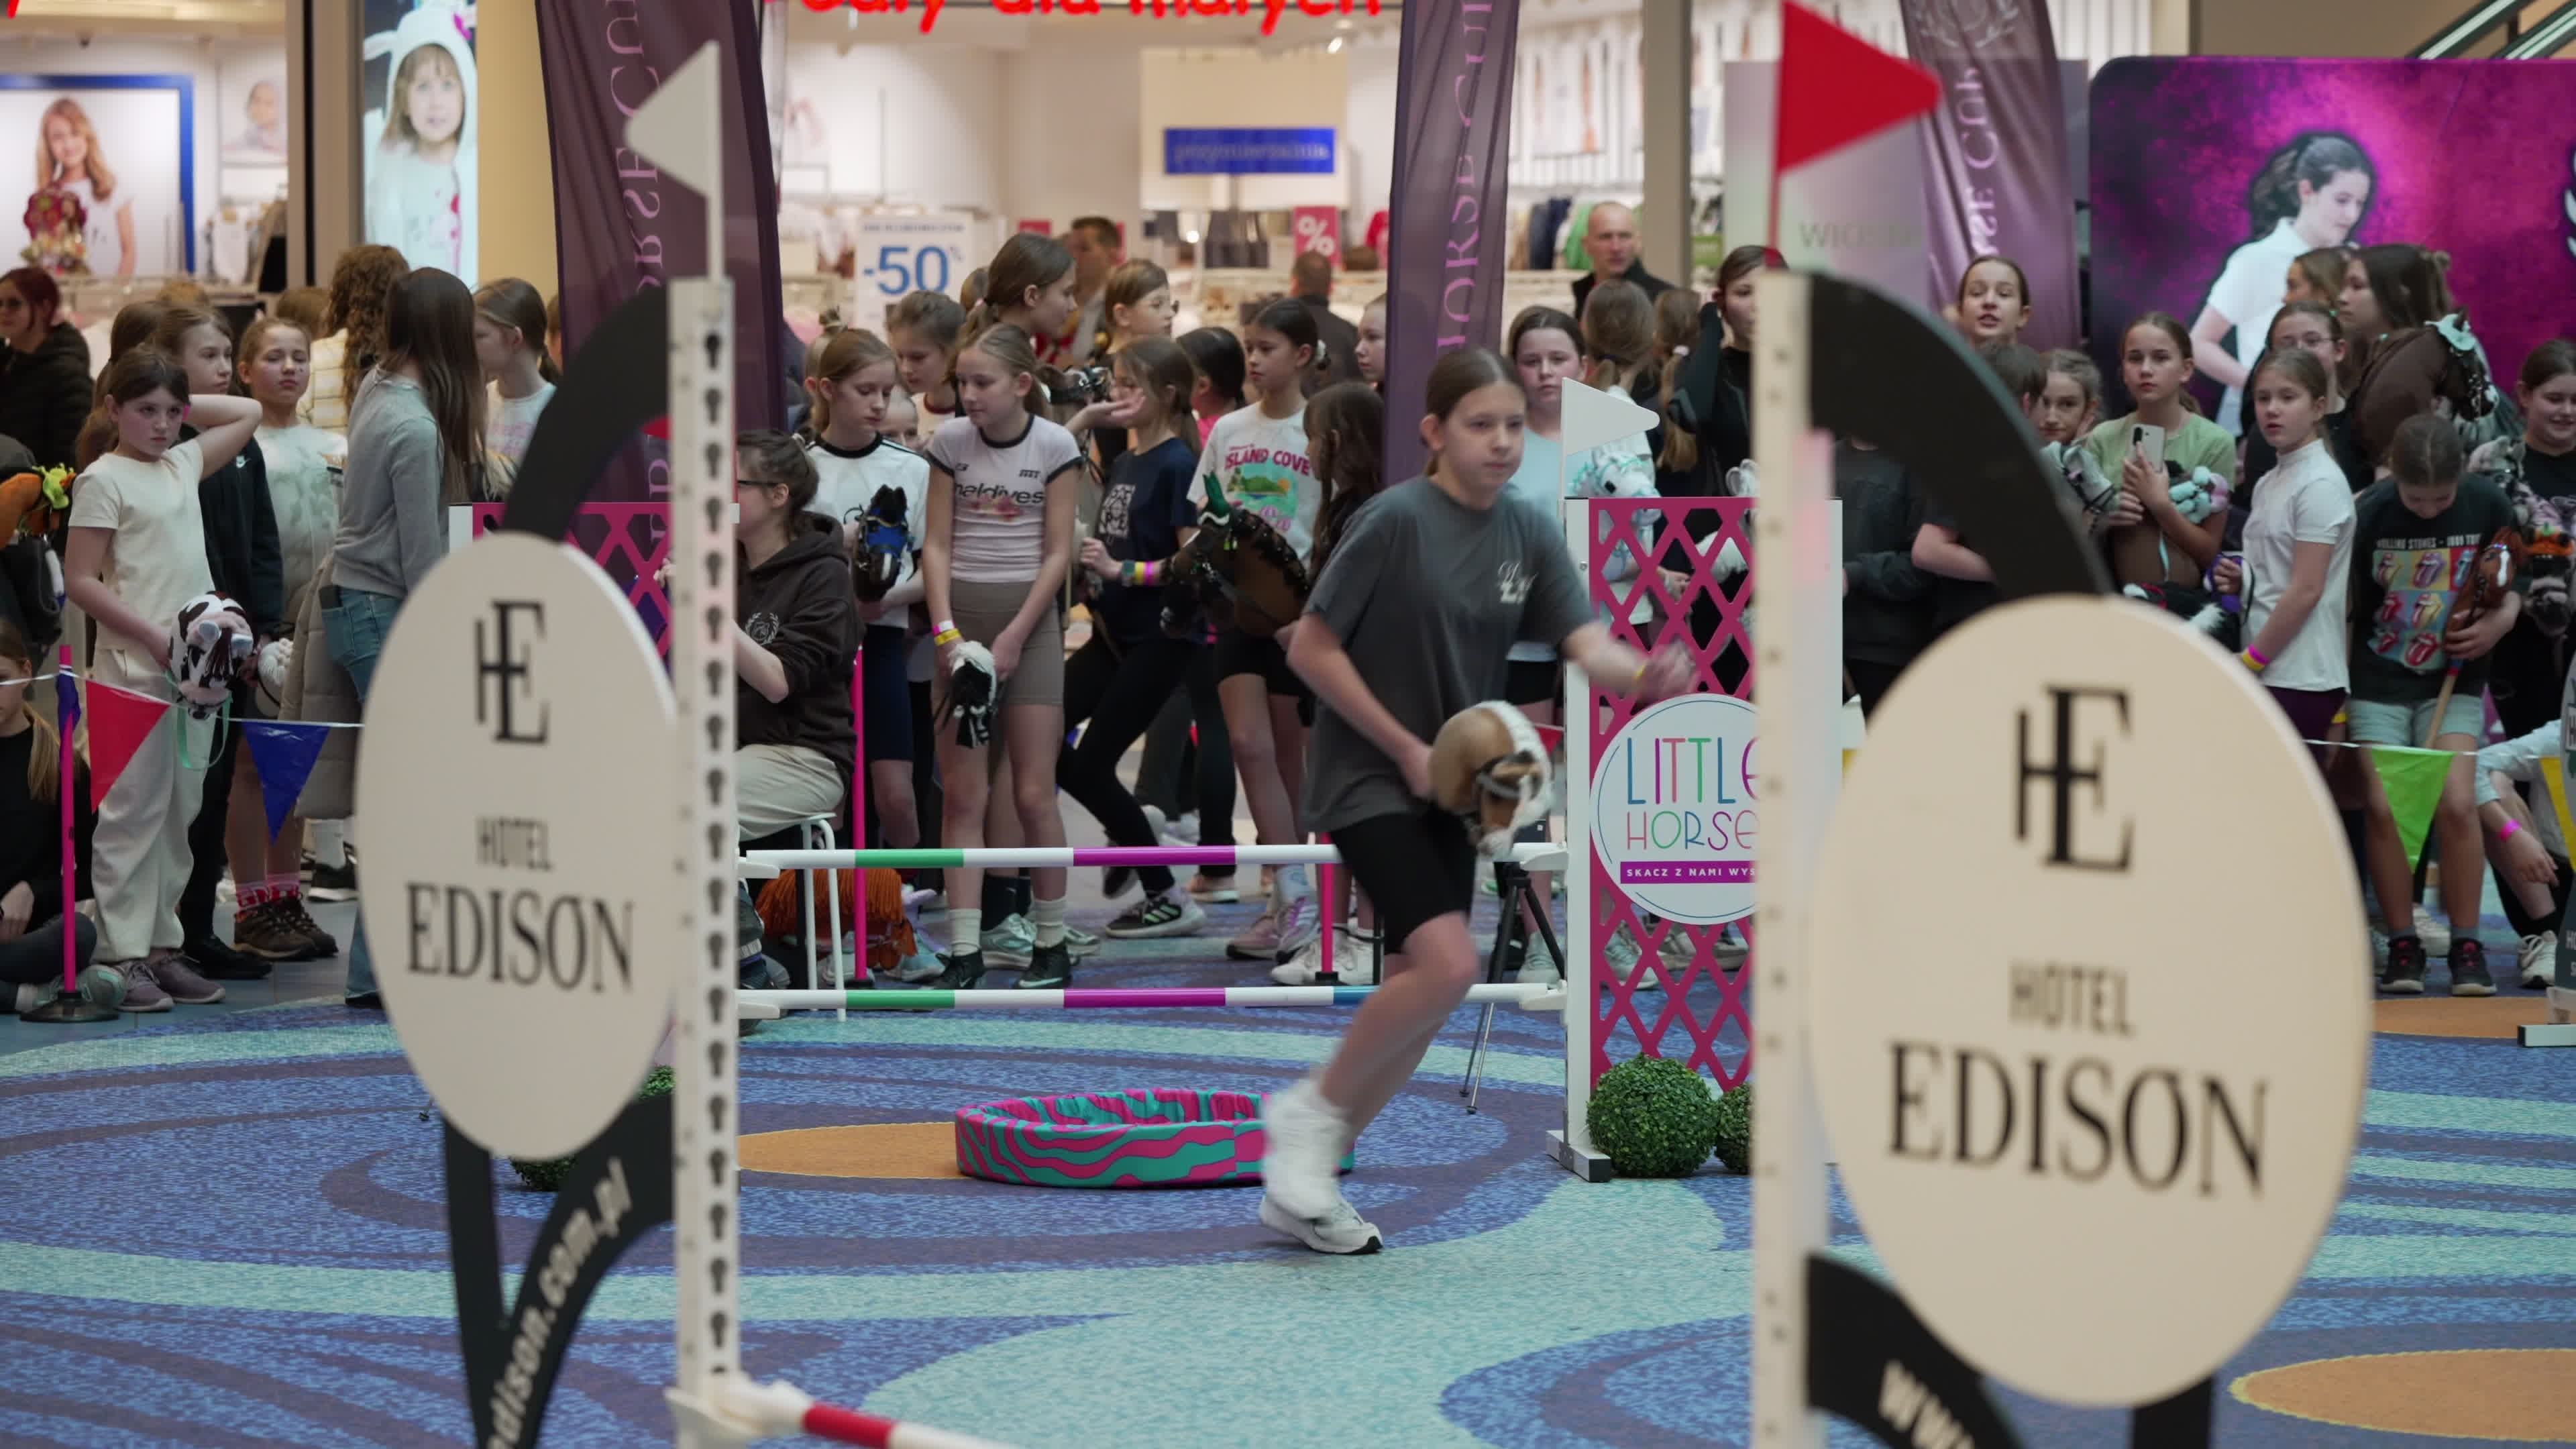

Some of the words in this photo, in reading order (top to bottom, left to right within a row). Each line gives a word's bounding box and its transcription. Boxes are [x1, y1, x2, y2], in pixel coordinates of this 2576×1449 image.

[477, 816, 553, 871] HOTEL
[1627, 869, 1668, 877] SKACZ
[1675, 868, 1682, 877] Z
[1689, 868, 1722, 877] NAMI
[405, 881, 633, 994] EDISON
[2010, 959, 2136, 1038] HOTEL
[1887, 1039, 2267, 1199] EDISON
[486, 1156, 633, 1449] dison.com.pl
